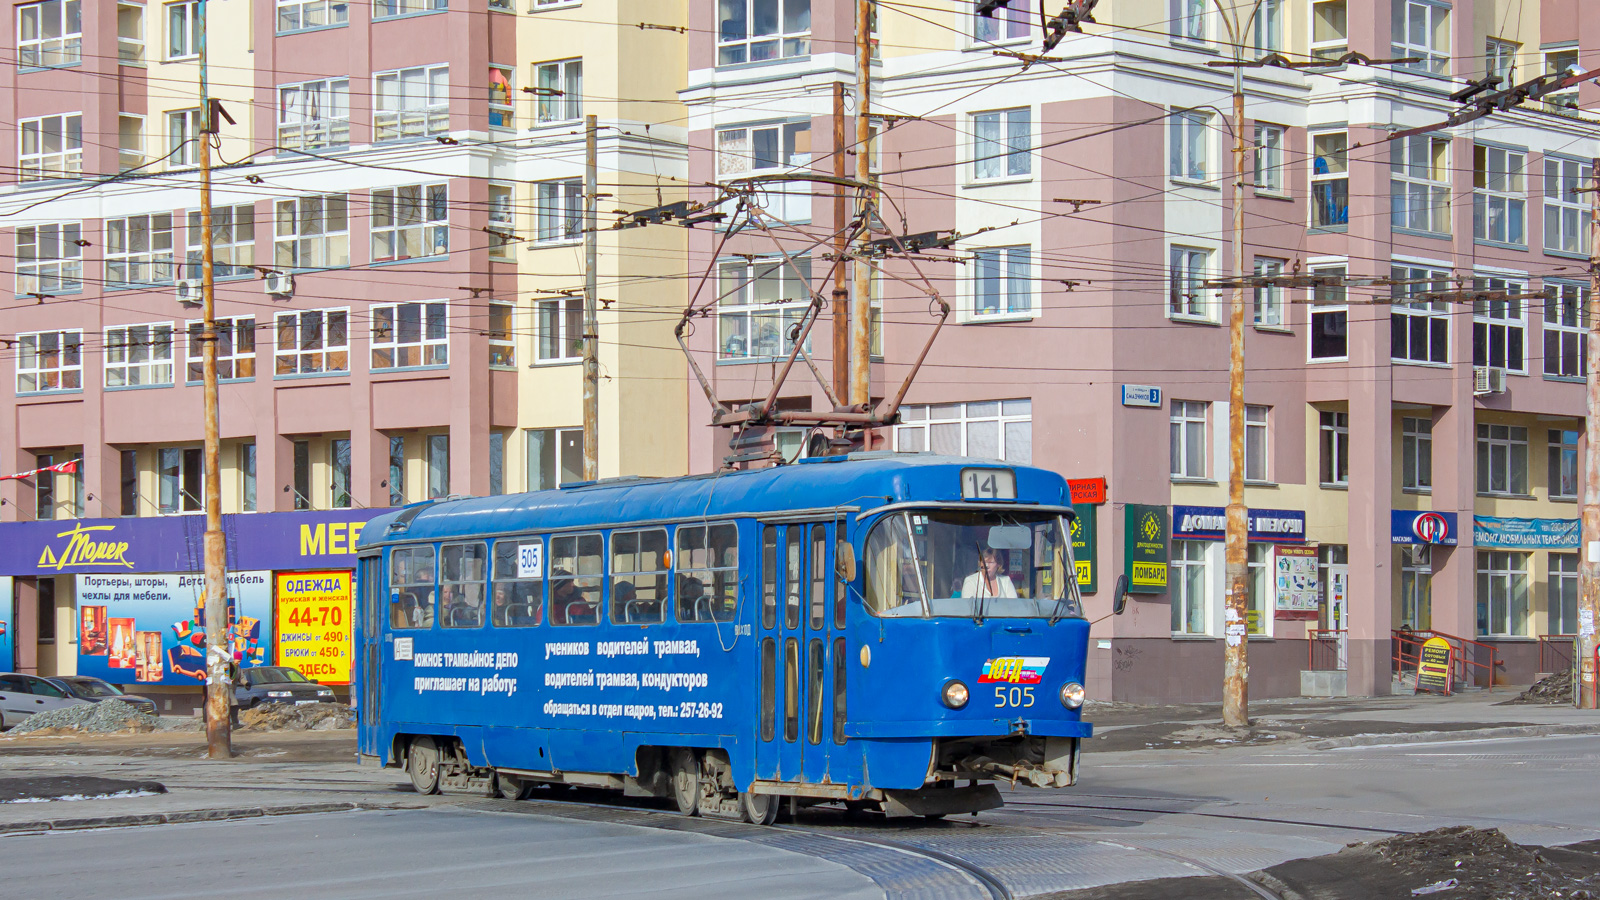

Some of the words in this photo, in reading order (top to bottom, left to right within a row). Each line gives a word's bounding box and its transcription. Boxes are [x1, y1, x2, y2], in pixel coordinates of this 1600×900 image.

[1152, 390, 1157, 401] 3
[969, 473, 998, 498] 14
[1256, 517, 1303, 534] МЕЛОЧИ
[521, 548, 538, 568] 505
[84, 576, 132, 588] Портьеры,
[135, 577, 168, 588] шторы,
[227, 574, 265, 584] мебель
[1134, 566, 1166, 582] ЛОМБАРД
[286, 578, 342, 594] ОДЕЖДА
[82, 591, 111, 601] чехлы
[113, 593, 131, 602] для
[280, 596, 311, 605] мужская
[288, 606, 343, 627] 44-70
[280, 632, 313, 644] ДЖИНСЫ
[323, 631, 343, 642] 490
[285, 648, 310, 658] БРЮКИ
[319, 646, 339, 658] 450
[545, 641, 590, 660] учеников
[597, 637, 649, 658] водителей
[653, 639, 701, 659] трамвая,
[414, 653, 443, 667] ЮЖНОЕ
[444, 650, 495, 668] ТРАМВАЙНОЕ
[495, 652, 519, 670] ДЕПО
[298, 663, 337, 677] ЗДЕСЬ
[987, 658, 1025, 683] ЮТД
[414, 677, 467, 695] приглашает
[468, 678, 480, 691] на
[481, 673, 517, 697] работу:
[544, 668, 594, 689] водителей
[596, 672, 640, 690] трамвая,
[642, 672, 708, 692] кондукторов
[995, 686, 1035, 708] 505
[543, 699, 591, 718] обращаться
[592, 704, 597, 715] в
[598, 704, 623, 718] отдел
[624, 703, 656, 720] кадров,
[680, 701, 723, 719] 257-26-92
